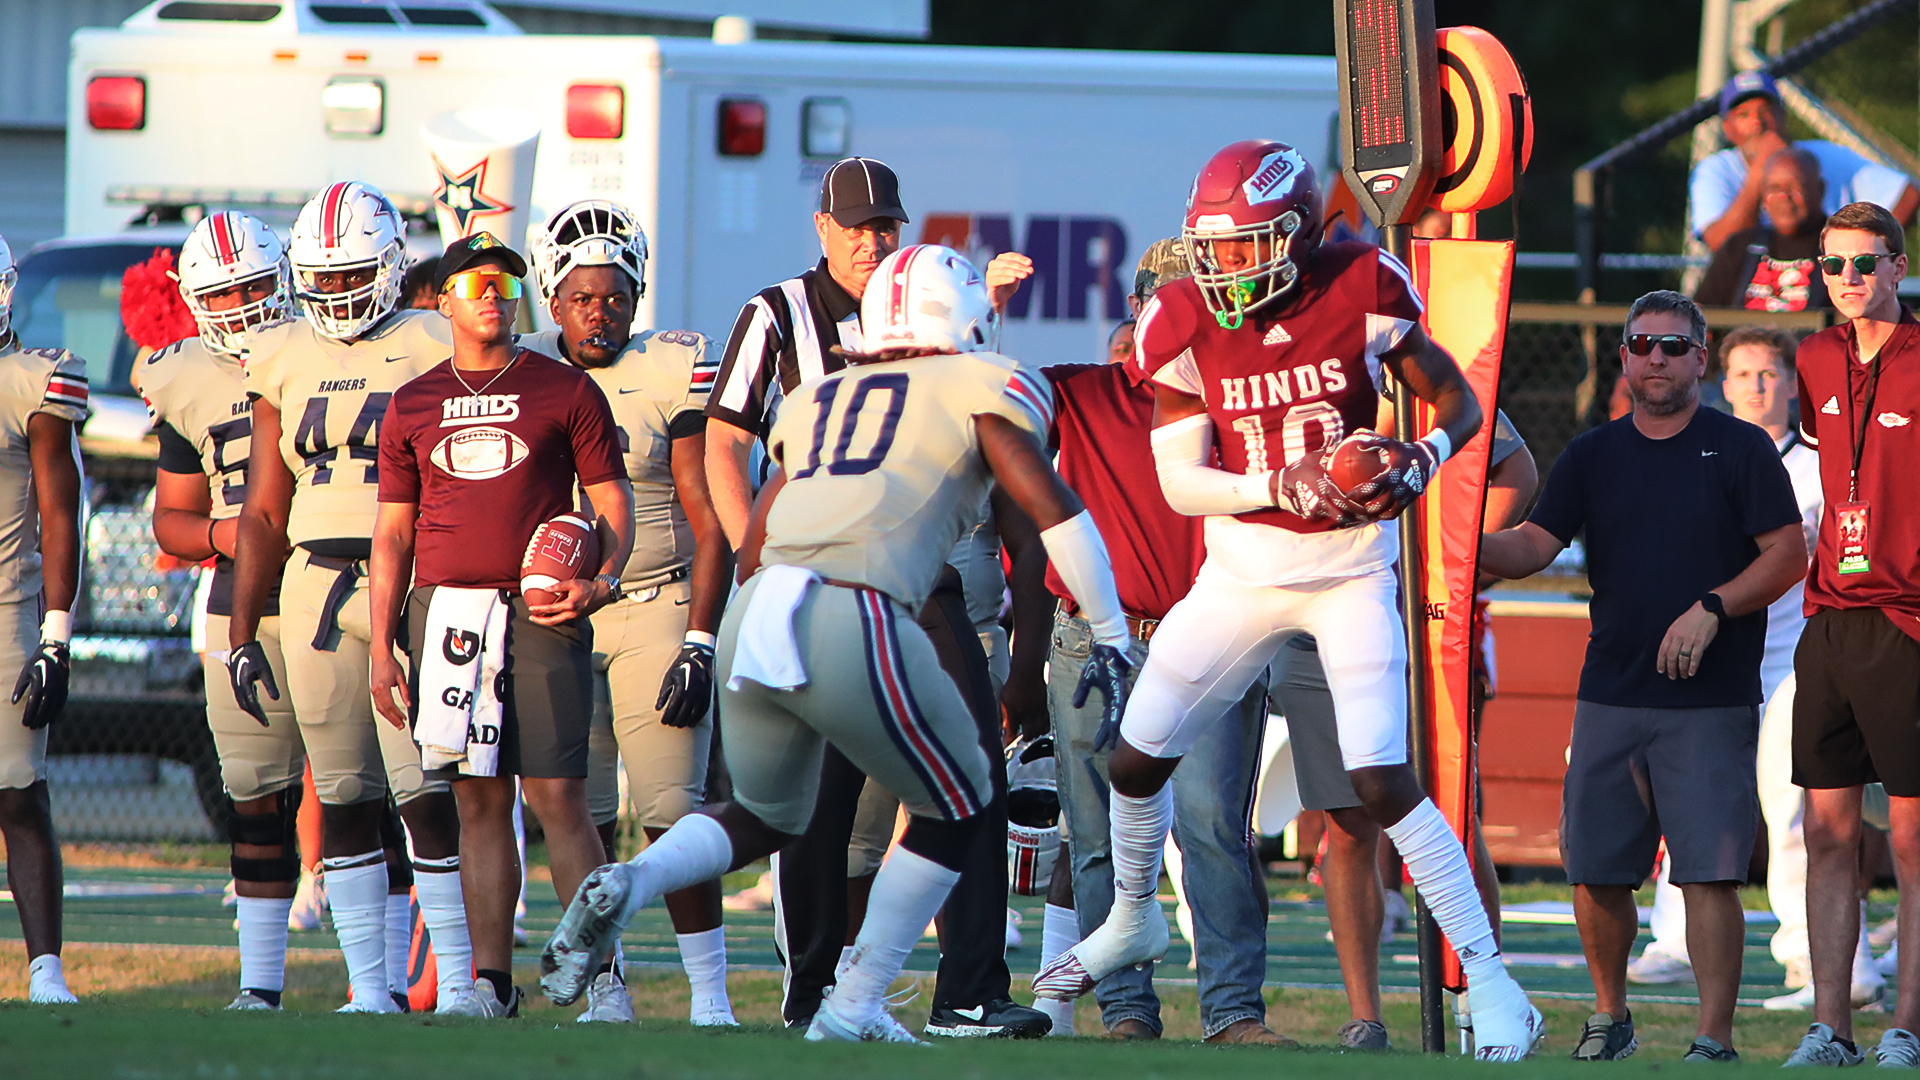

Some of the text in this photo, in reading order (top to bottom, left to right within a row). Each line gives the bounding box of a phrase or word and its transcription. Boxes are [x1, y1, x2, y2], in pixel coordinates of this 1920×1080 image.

[1250, 155, 1294, 198] HINDS
[1262, 334, 1292, 346] adidas
[318, 378, 367, 393] RANGERS
[1220, 358, 1347, 411] HINDS
[231, 400, 253, 416] RAN
[439, 394, 521, 428] HINDS
[789, 372, 910, 481] 10
[1231, 400, 1344, 476] 10
[1296, 480, 1311, 518] adidas
